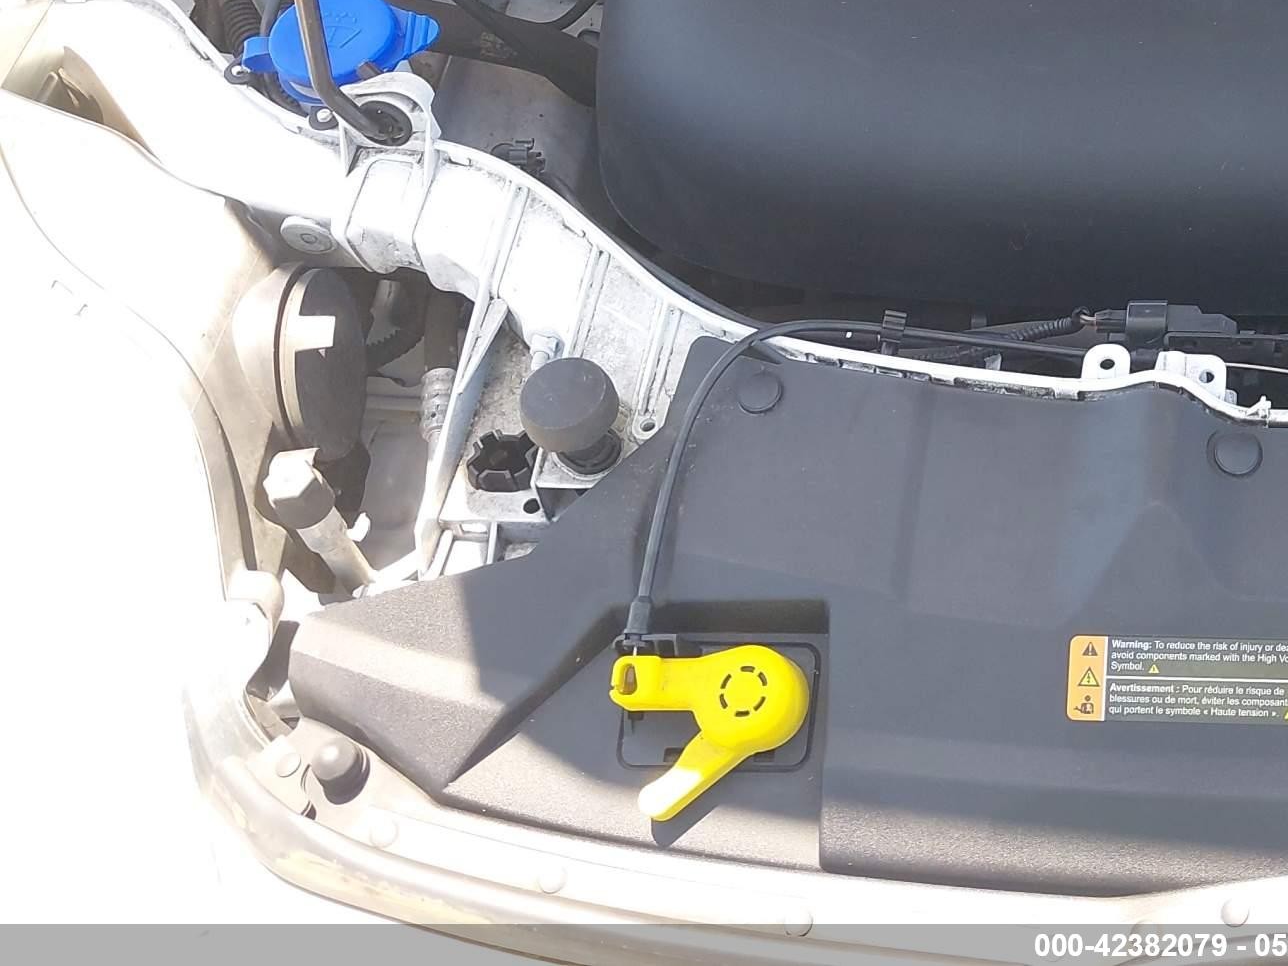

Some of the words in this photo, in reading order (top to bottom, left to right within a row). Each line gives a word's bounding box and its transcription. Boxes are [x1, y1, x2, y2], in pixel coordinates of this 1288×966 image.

[1111, 639, 1152, 651] Warning:
[1154, 641, 1165, 649] To
[1166, 642, 1195, 650] reduce
[1197, 642, 1211, 650] the
[1212, 642, 1228, 650] risk
[1229, 642, 1239, 651] of
[1240, 643, 1263, 653] injury
[1111, 651, 1134, 659] avoid
[1135, 652, 1188, 661] components
[1189, 653, 1220, 661] marked
[1222, 654, 1240, 662] with
[1241, 654, 1256, 662] the
[1257, 654, 1277, 665] High
[1110, 661, 1145, 672] Symbol.
[1109, 683, 1174, 693] Avertissement
[1181, 685, 1204, 694] Pour
[1204, 686, 1234, 694] réduire
[1235, 686, 1244, 694] le
[1245, 687, 1272, 697] risque
[1273, 687, 1285, 695] de
[1109, 695, 1150, 704] blessures
[1151, 696, 1163, 704] ou
[1164, 695, 1176, 704] de
[1201, 696, 1225, 705] éviter
[1226, 697, 1240, 705] les
[1108, 705, 1122, 715] qui
[1123, 706, 1154, 716] portent
[1155, 706, 1164, 714] le
[1165, 707, 1201, 716] symbole
[1210, 708, 1236, 716] Haute
[1238, 708, 1269, 717] tension
